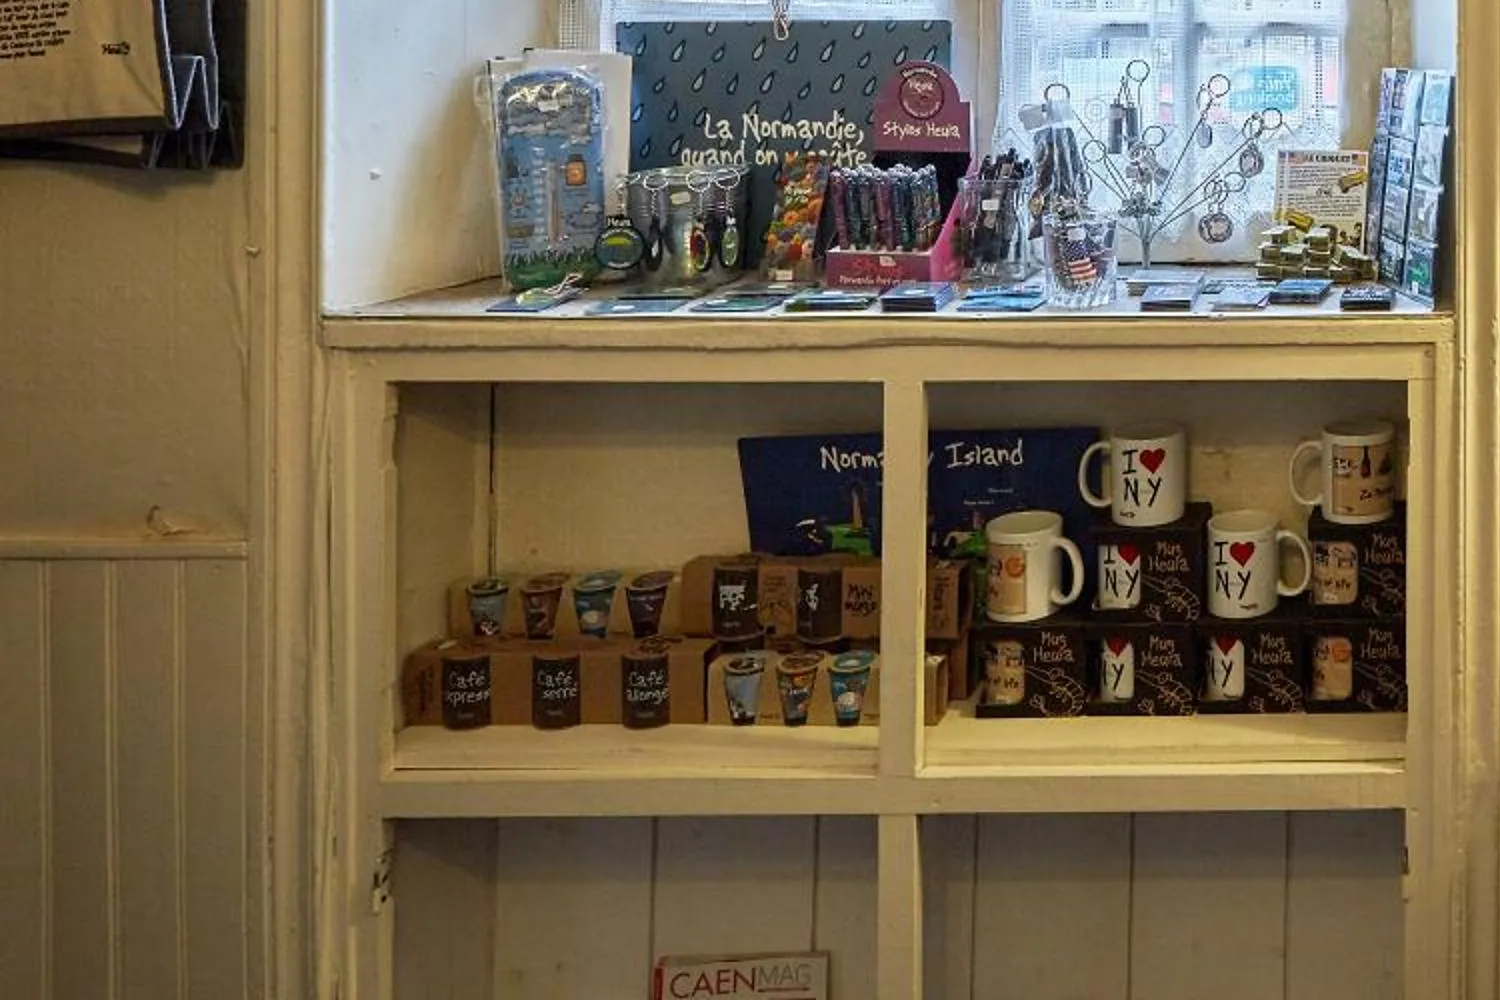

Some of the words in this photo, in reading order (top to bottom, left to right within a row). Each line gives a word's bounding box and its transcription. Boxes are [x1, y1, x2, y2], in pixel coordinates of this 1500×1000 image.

[704, 113, 733, 141] La
[742, 109, 865, 147] Normandie,
[945, 439, 1024, 468] Island
[1121, 449, 1138, 474] I
[1214, 541, 1229, 566] I
